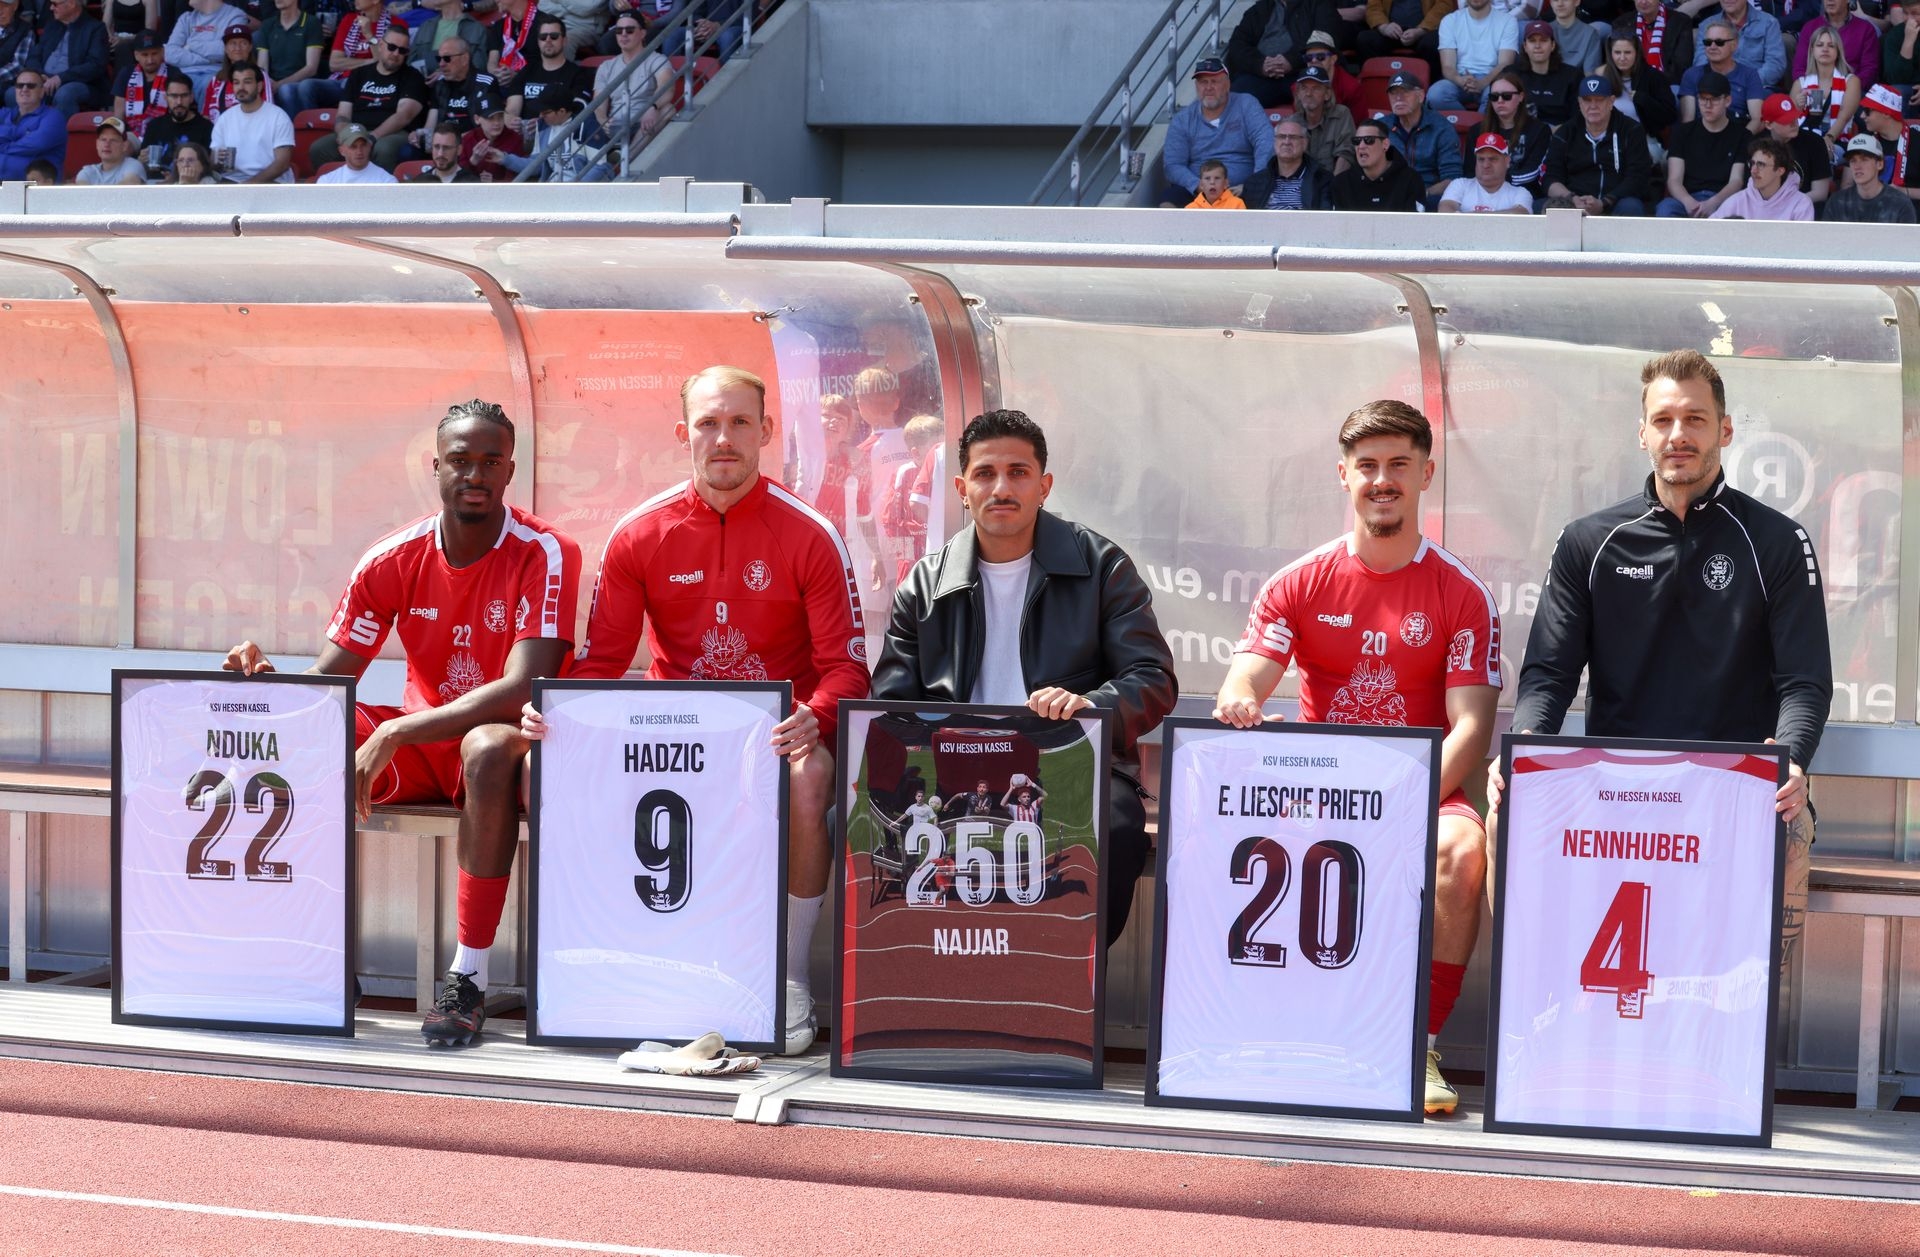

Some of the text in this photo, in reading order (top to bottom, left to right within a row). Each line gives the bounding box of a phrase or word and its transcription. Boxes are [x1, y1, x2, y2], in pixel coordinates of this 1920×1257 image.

[524, 85, 545, 96] KS
[619, 375, 663, 390] HESSEN
[669, 570, 704, 584] capelli
[1616, 565, 1654, 577] capelli
[715, 601, 728, 624] 9
[1317, 613, 1353, 625] capelli
[452, 624, 473, 648] 22
[1361, 629, 1389, 656] 20
[210, 703, 271, 713] KSV HESSEN KASSEL
[629, 714, 700, 725] KSV HESSEN KASSEL
[207, 729, 280, 761] NDUKA
[940, 741, 1014, 754] KSV HESSEN KASSEL
[624, 743, 705, 773] HADZIC
[1262, 755, 1340, 769] KSV HESSEN KASSEL
[1218, 785, 1383, 821] E. LIESCHE PRIETO
[1598, 789, 1683, 804] KSV HESSEN KASSEL
[185, 770, 295, 883] 22
[634, 788, 693, 914] 9
[1562, 828, 1701, 864] NENNHUBER
[905, 820, 1046, 908] 250
[1227, 836, 1366, 971] 20
[933, 927, 1010, 956] NAJJAR
[1580, 881, 1656, 1020] 4
